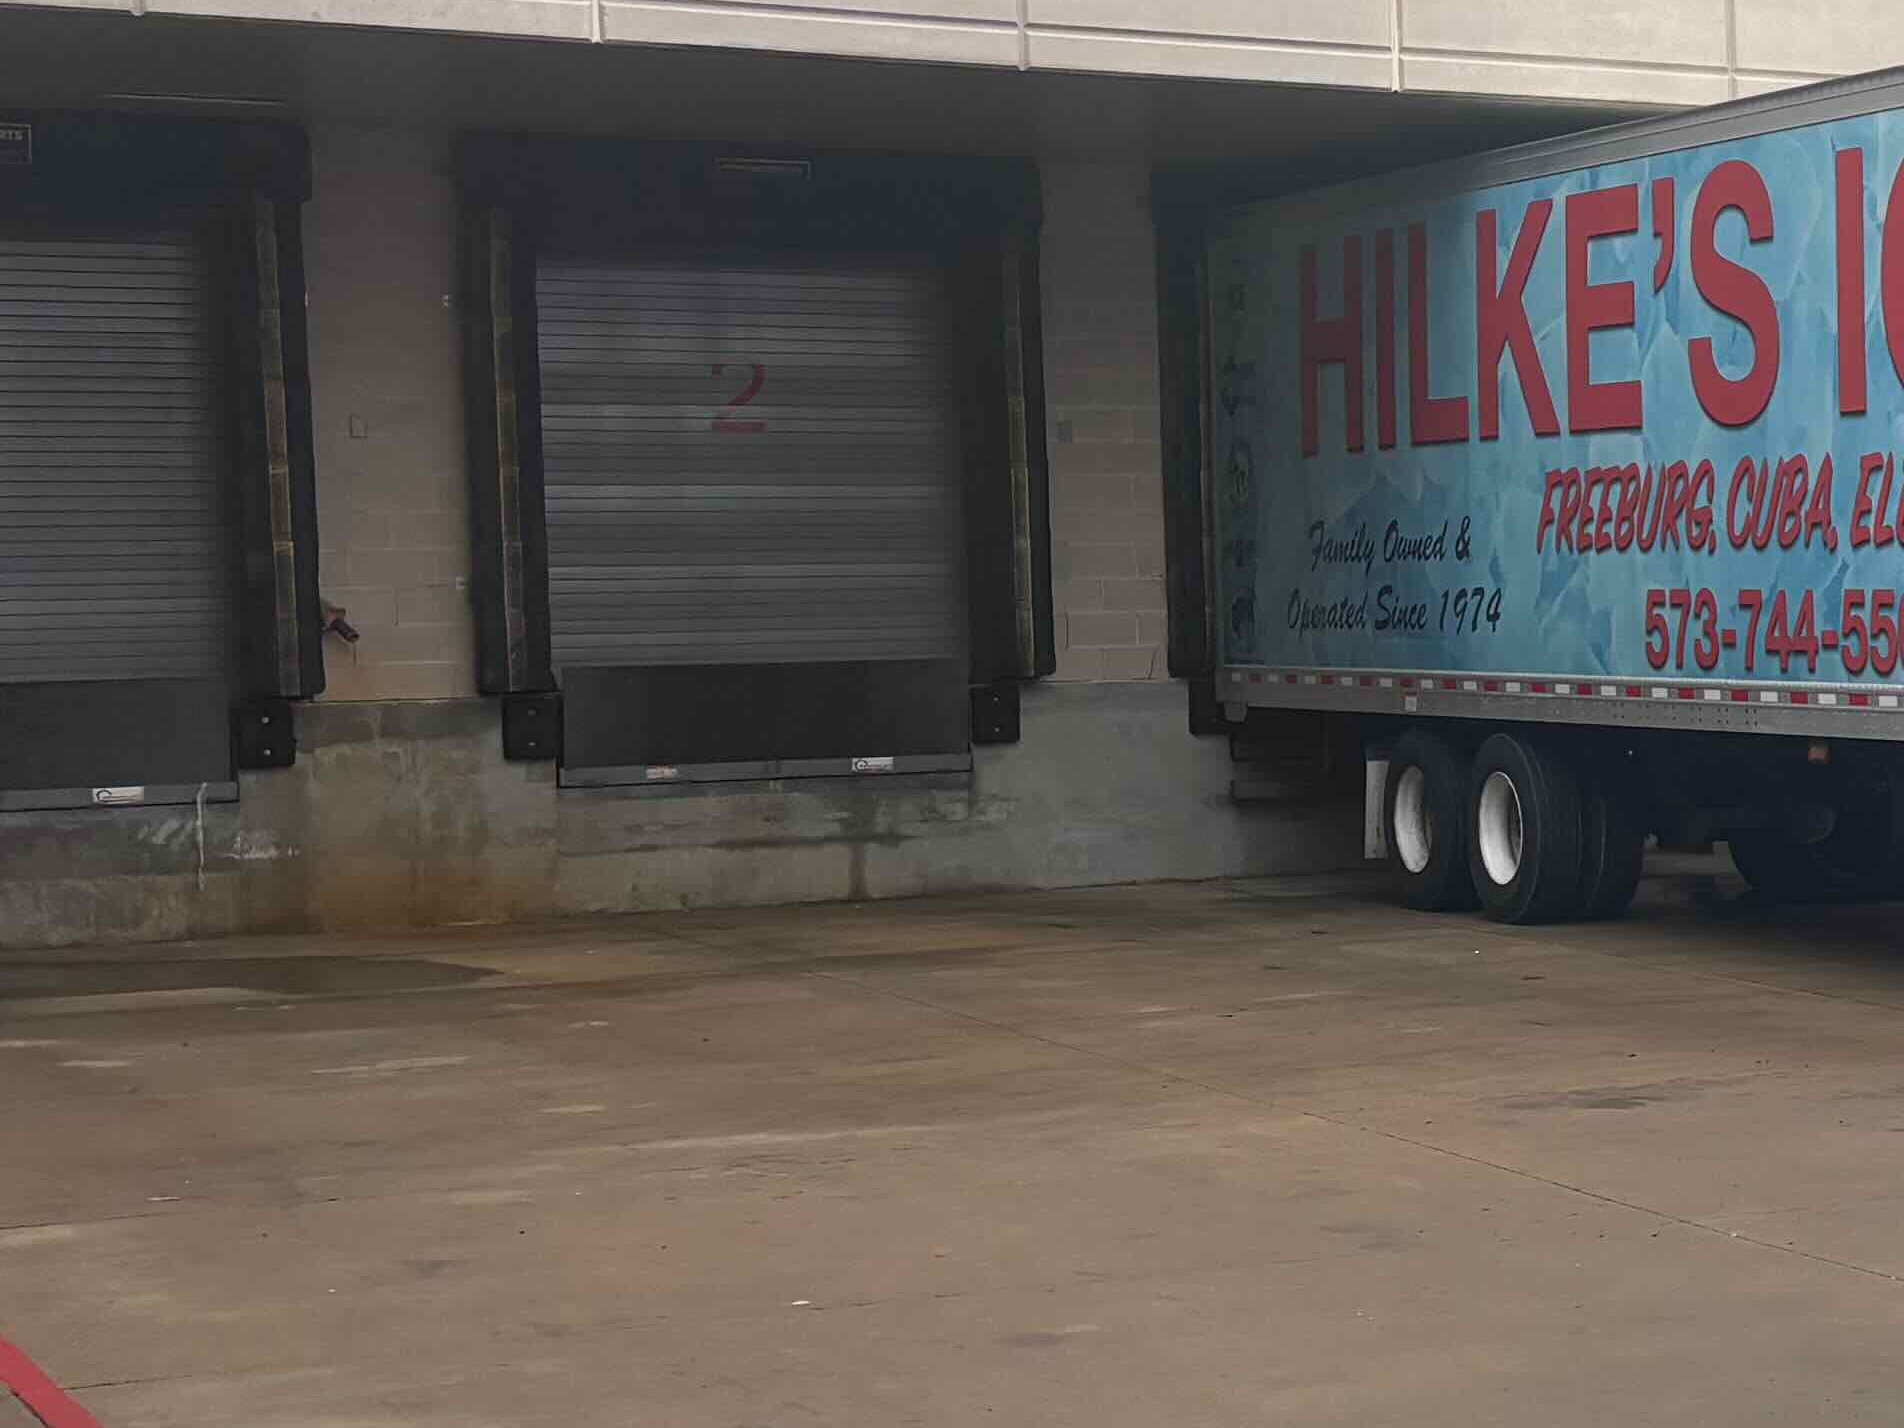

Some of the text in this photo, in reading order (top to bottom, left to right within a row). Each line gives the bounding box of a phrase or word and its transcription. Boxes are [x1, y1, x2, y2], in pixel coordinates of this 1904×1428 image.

[1298, 158, 1781, 457] HILKE'S
[712, 360, 768, 435] 2
[1536, 457, 1717, 555] FREEBURG,
[1726, 452, 1838, 551] CUBA,
[1308, 515, 1473, 577] Family Owned &
[1286, 584, 1503, 643] Operated Since 1974
